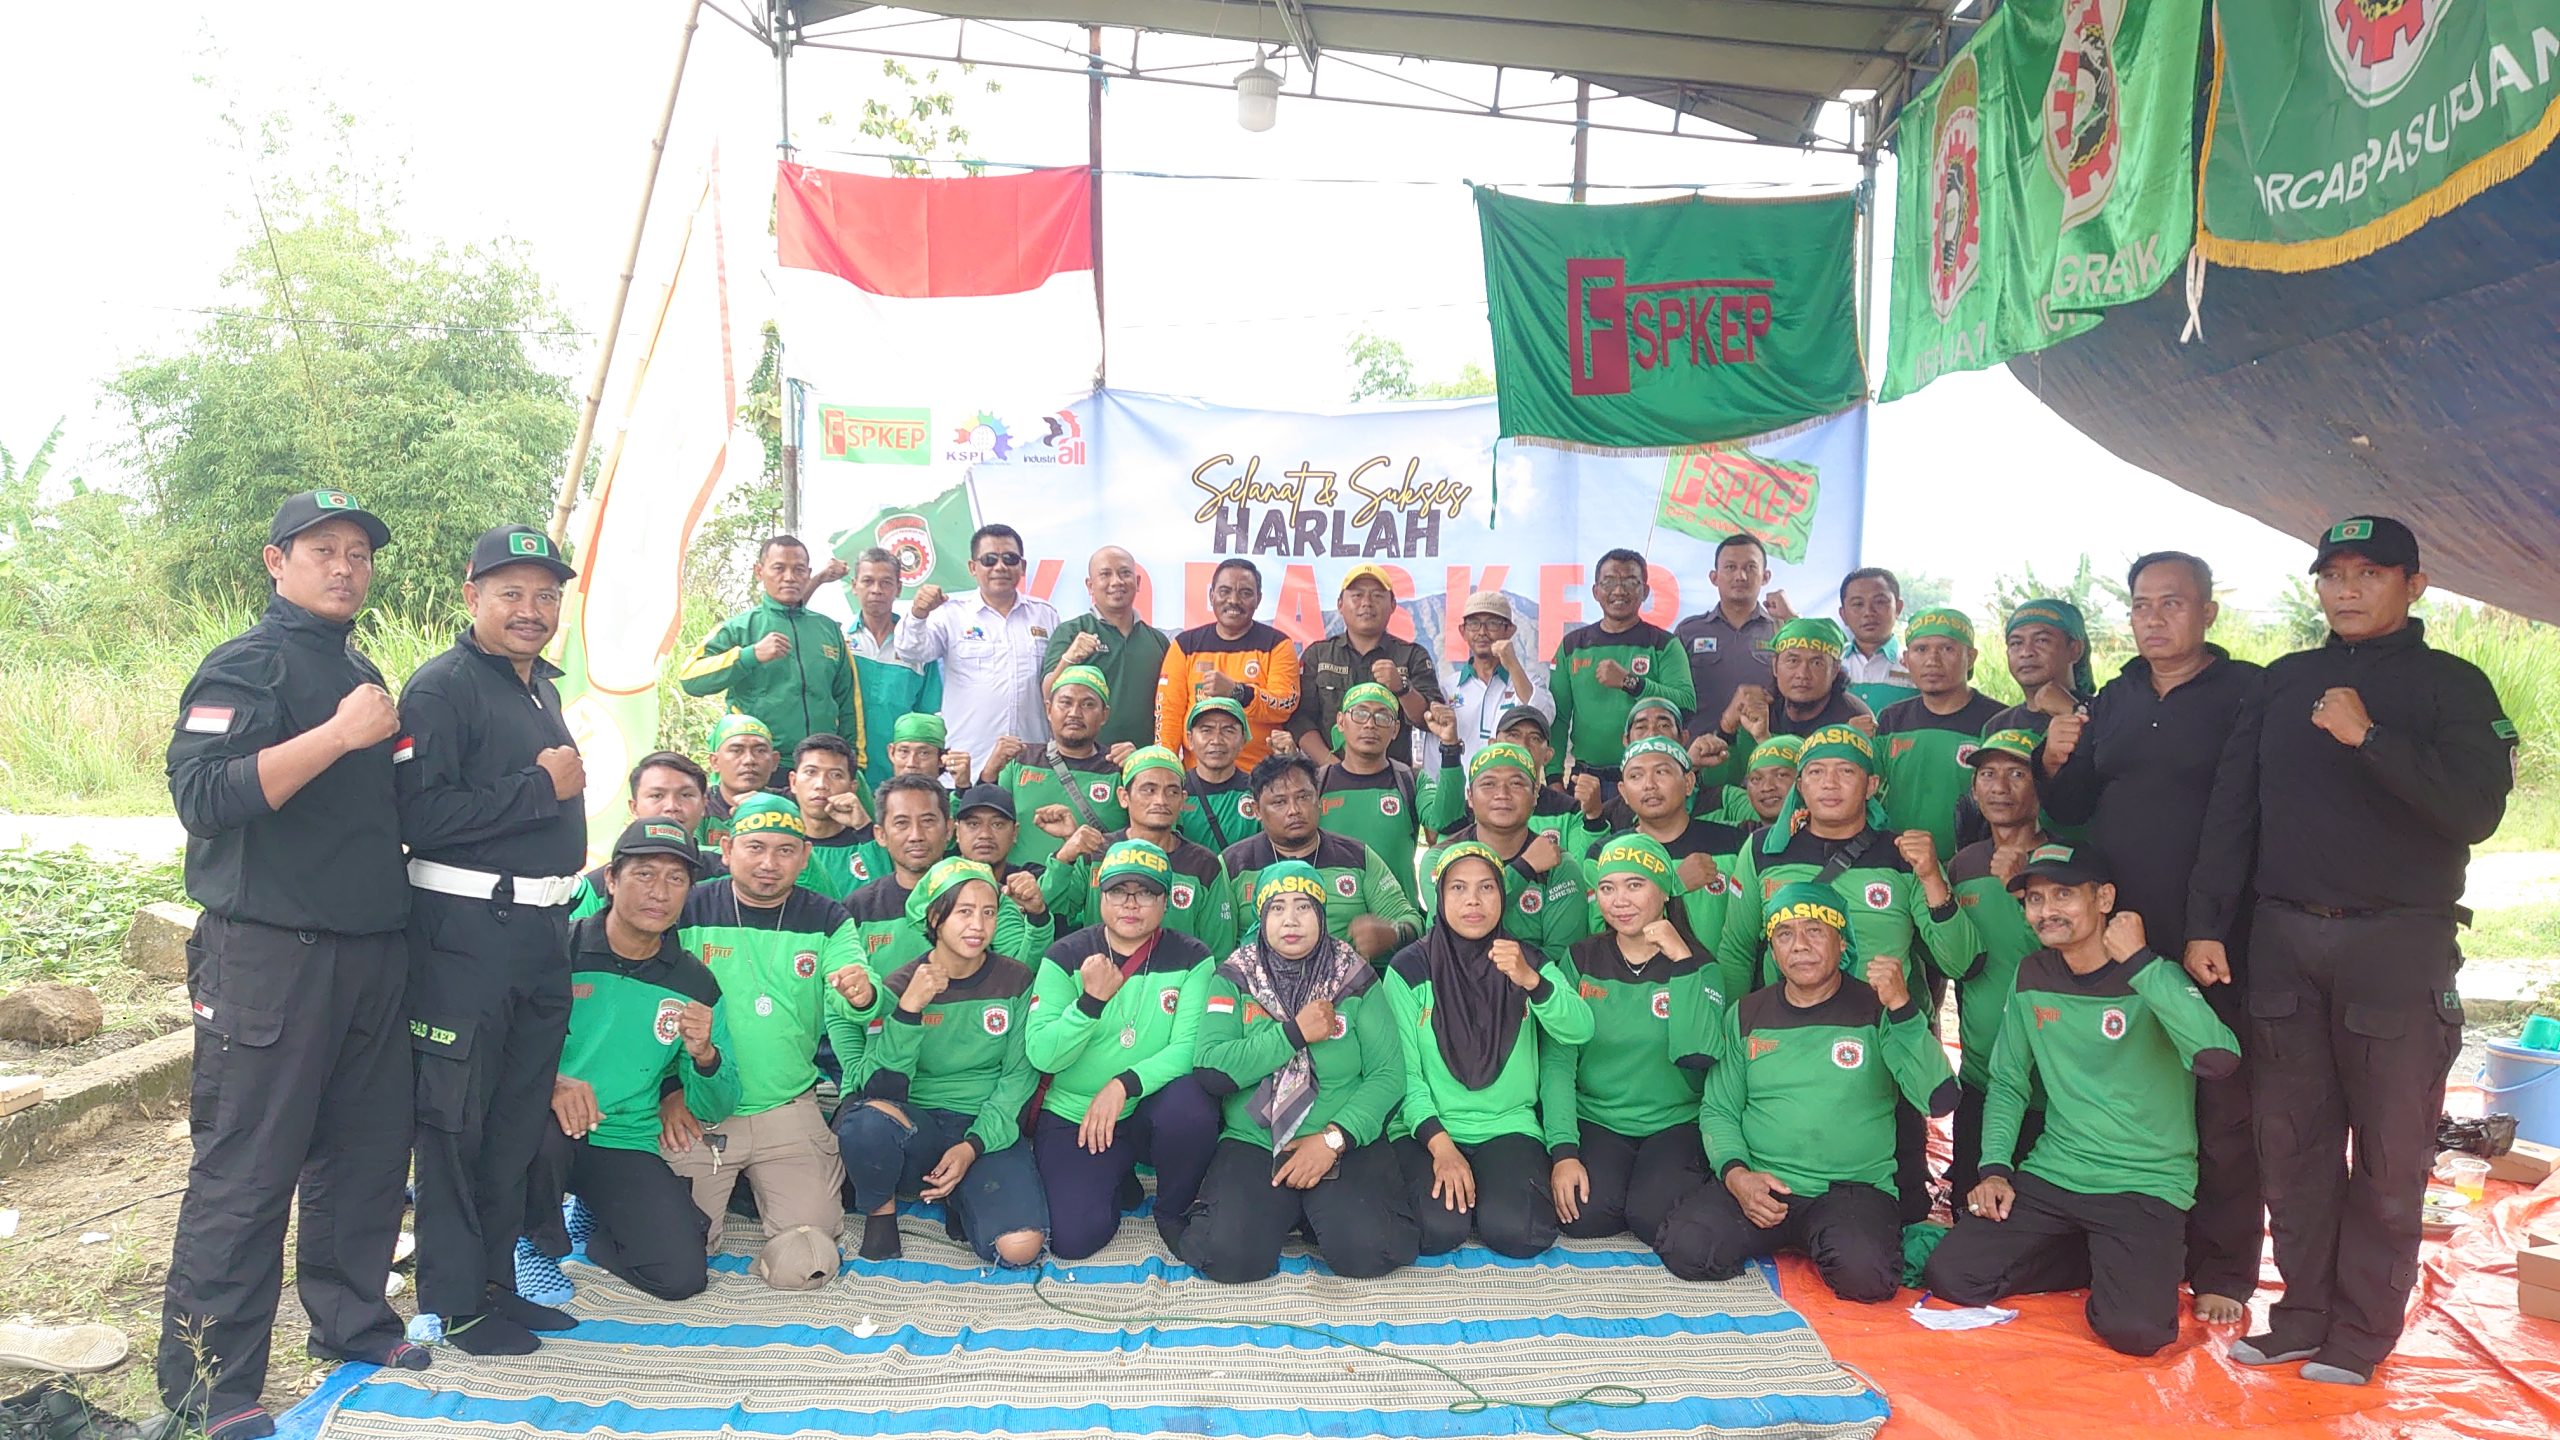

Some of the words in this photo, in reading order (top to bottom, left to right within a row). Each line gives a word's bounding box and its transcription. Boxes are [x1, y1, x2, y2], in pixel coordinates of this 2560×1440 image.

[2254, 153, 2367, 216] RCAB
[946, 451, 985, 464] KSPI
[1349, 456, 1473, 528] Sukses
[1213, 506, 1441, 559] HARLAH
[429, 1026, 457, 1046] KEP
